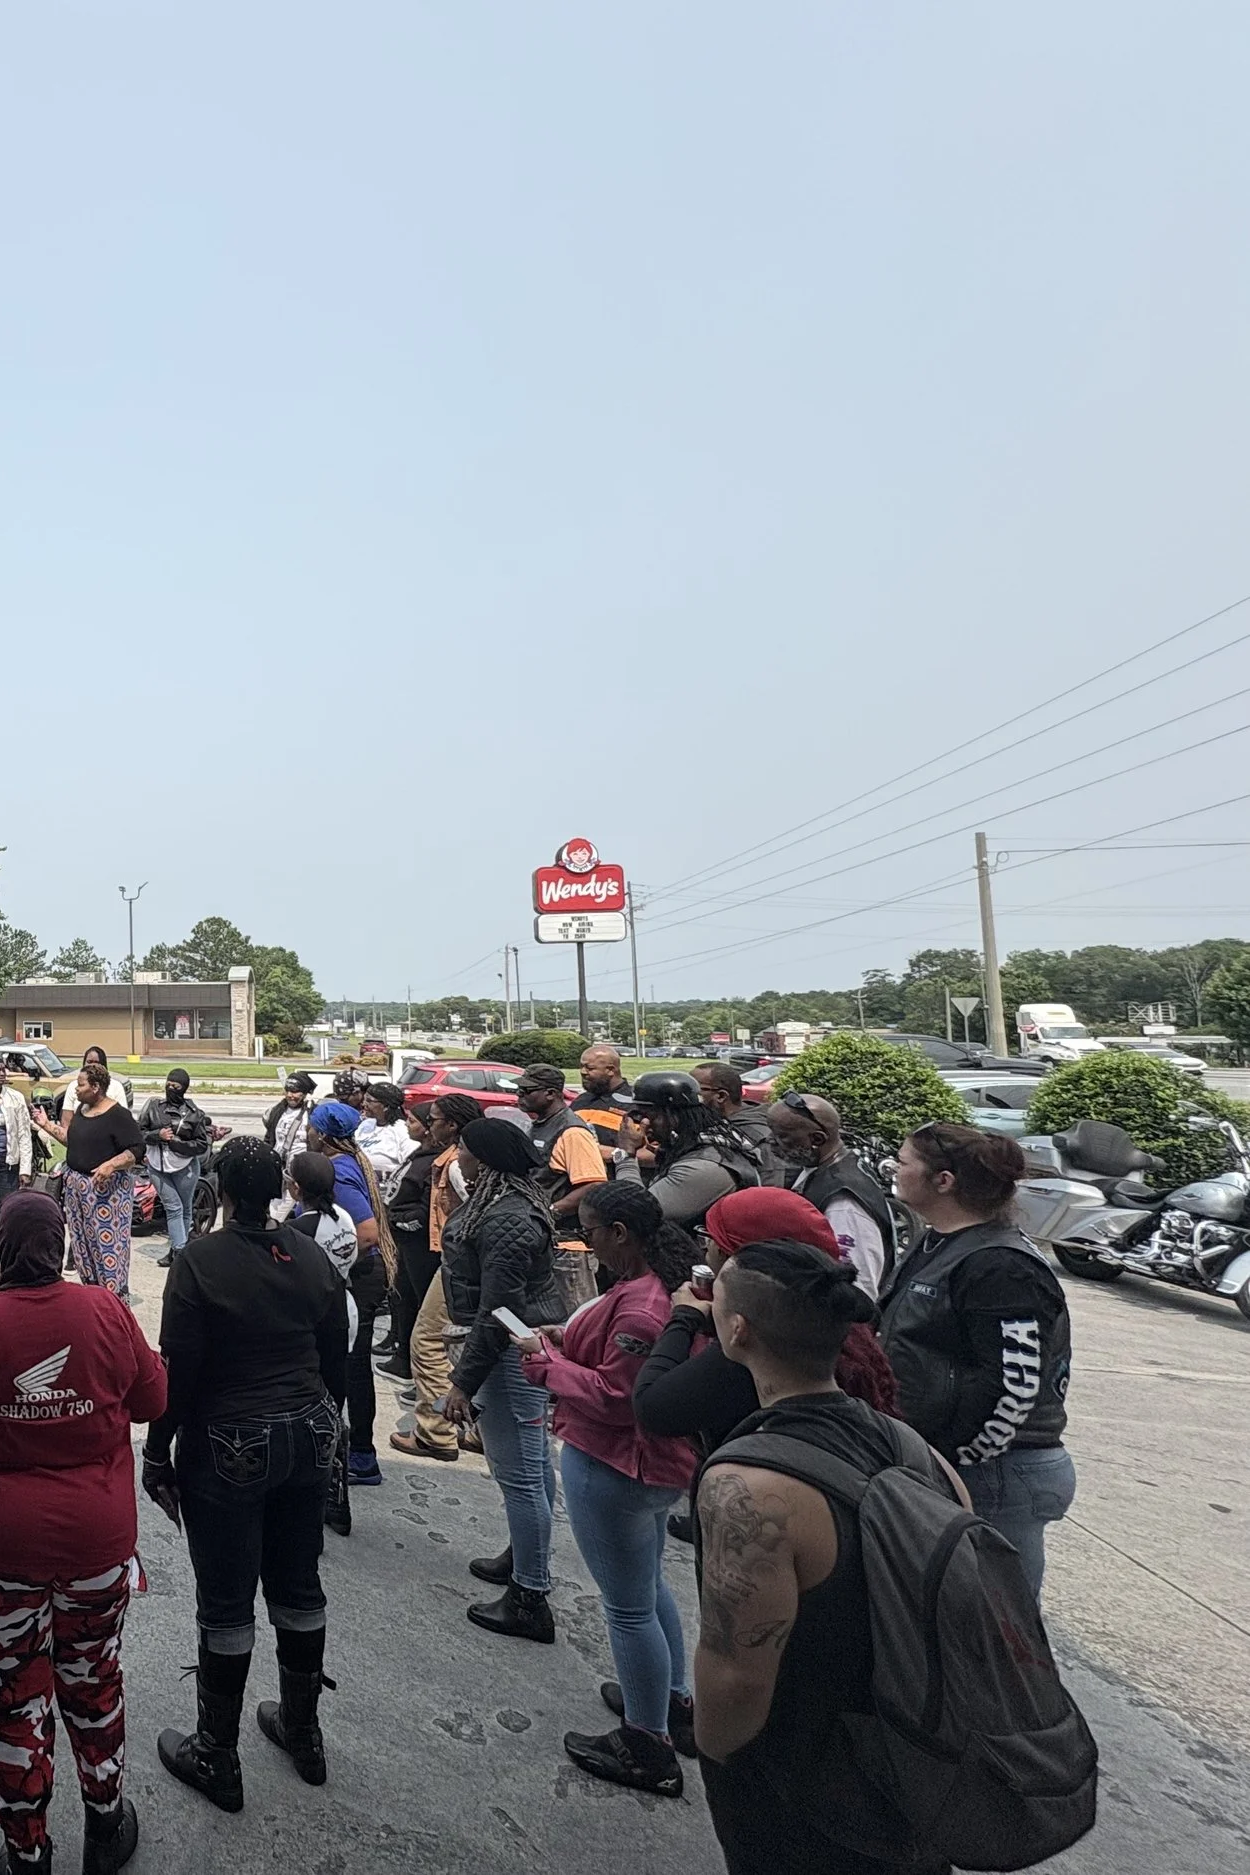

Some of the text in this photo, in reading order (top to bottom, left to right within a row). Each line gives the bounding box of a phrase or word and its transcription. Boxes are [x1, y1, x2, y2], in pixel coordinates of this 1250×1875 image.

[541, 873, 619, 905] Wendy's
[15, 1388, 78, 1403] HONDA
[0, 1399, 94, 1419] SHADOW 750
